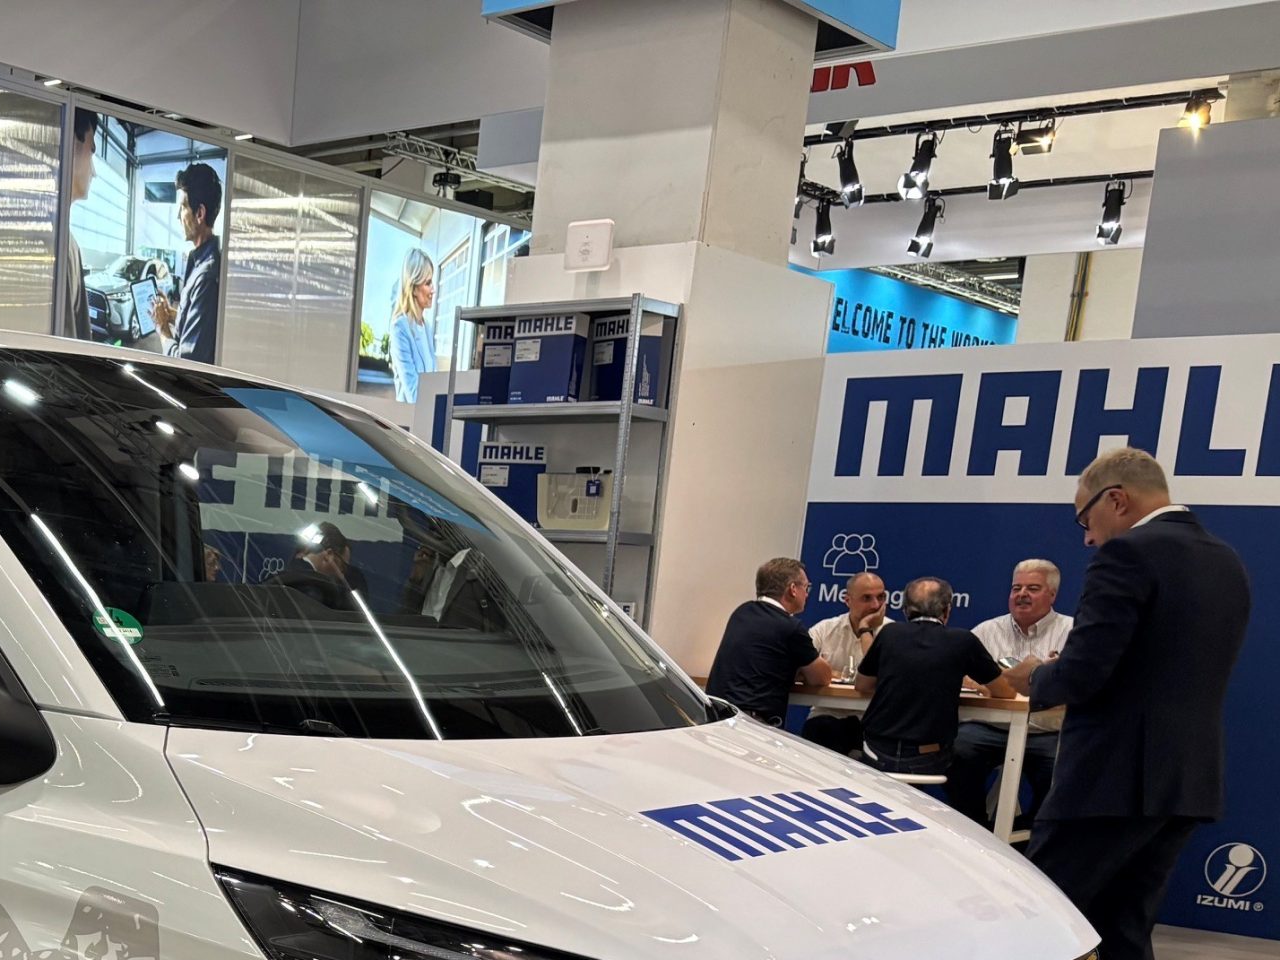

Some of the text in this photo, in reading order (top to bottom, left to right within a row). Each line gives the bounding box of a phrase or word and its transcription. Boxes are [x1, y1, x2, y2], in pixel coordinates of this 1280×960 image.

[517, 315, 574, 333] MAHLE
[832, 297, 894, 344] ELCOME
[898, 315, 916, 349] TO
[834, 363, 1280, 477] MAHL
[483, 445, 545, 461] MAHLE
[638, 787, 928, 862] MAHLE
[1196, 894, 1251, 911] IZUMI
